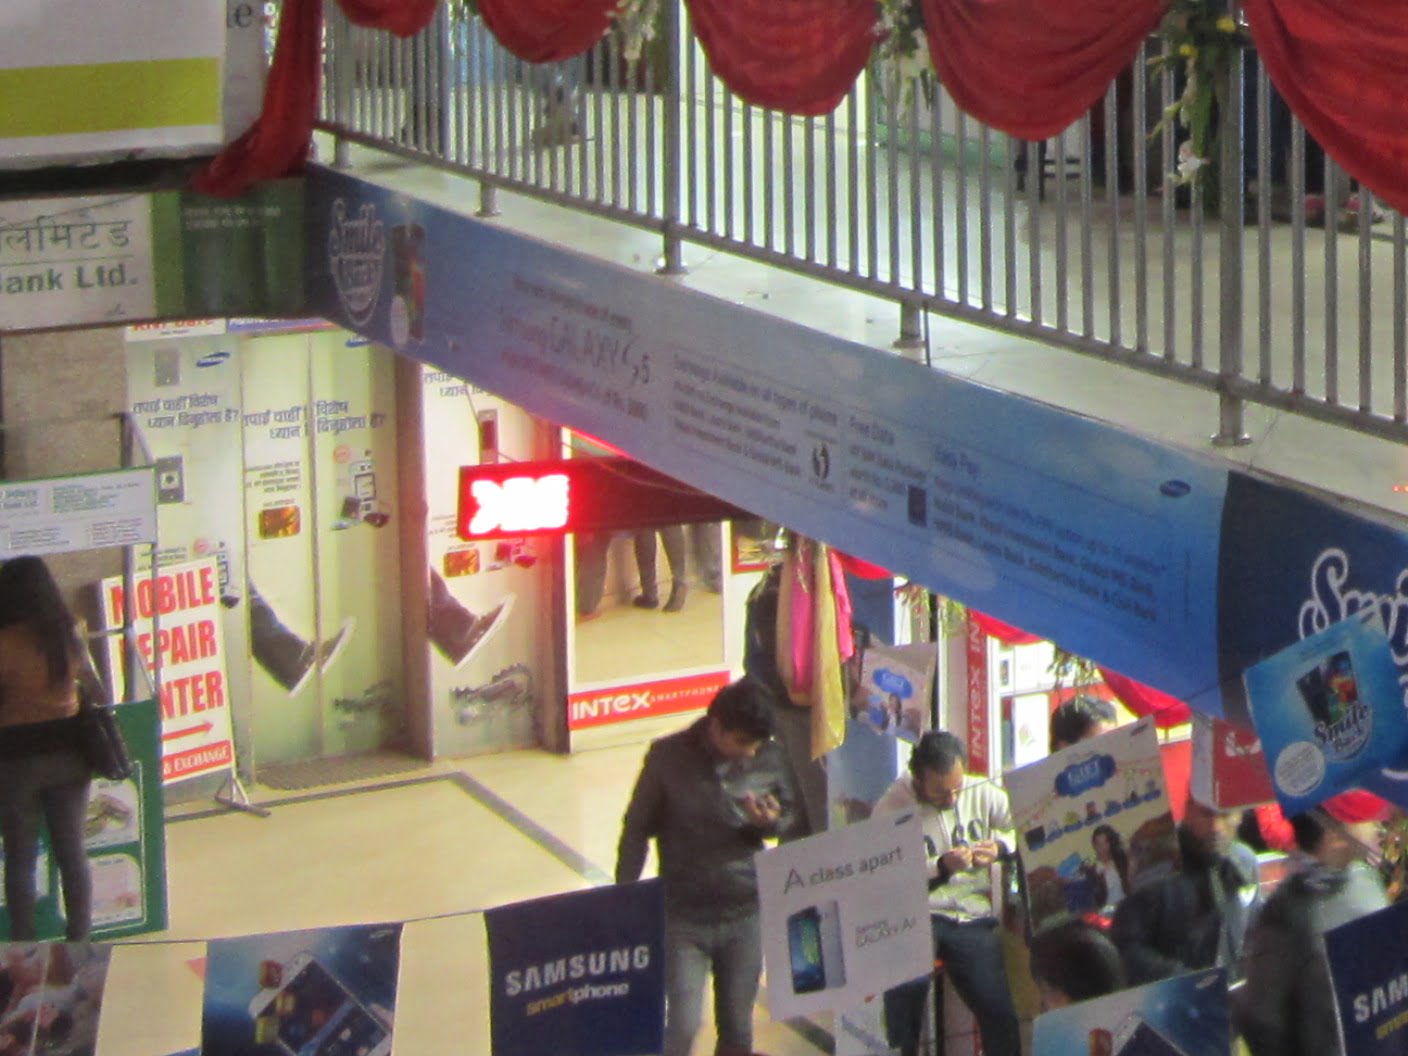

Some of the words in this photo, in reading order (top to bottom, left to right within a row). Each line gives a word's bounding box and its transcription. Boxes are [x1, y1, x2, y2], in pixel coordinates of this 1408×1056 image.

[0, 267, 63, 294] ank
[76, 263, 138, 290] Ltd.
[110, 566, 216, 625] MOBILE
[119, 619, 217, 672] EPAIR
[160, 670, 225, 720] NTER
[173, 745, 231, 773] EXCHANGE
[784, 868, 806, 895] A
[808, 863, 855, 887] class
[858, 845, 903, 875] apart
[504, 944, 651, 997] SAMSUNG
[525, 981, 631, 1018] smartphone
